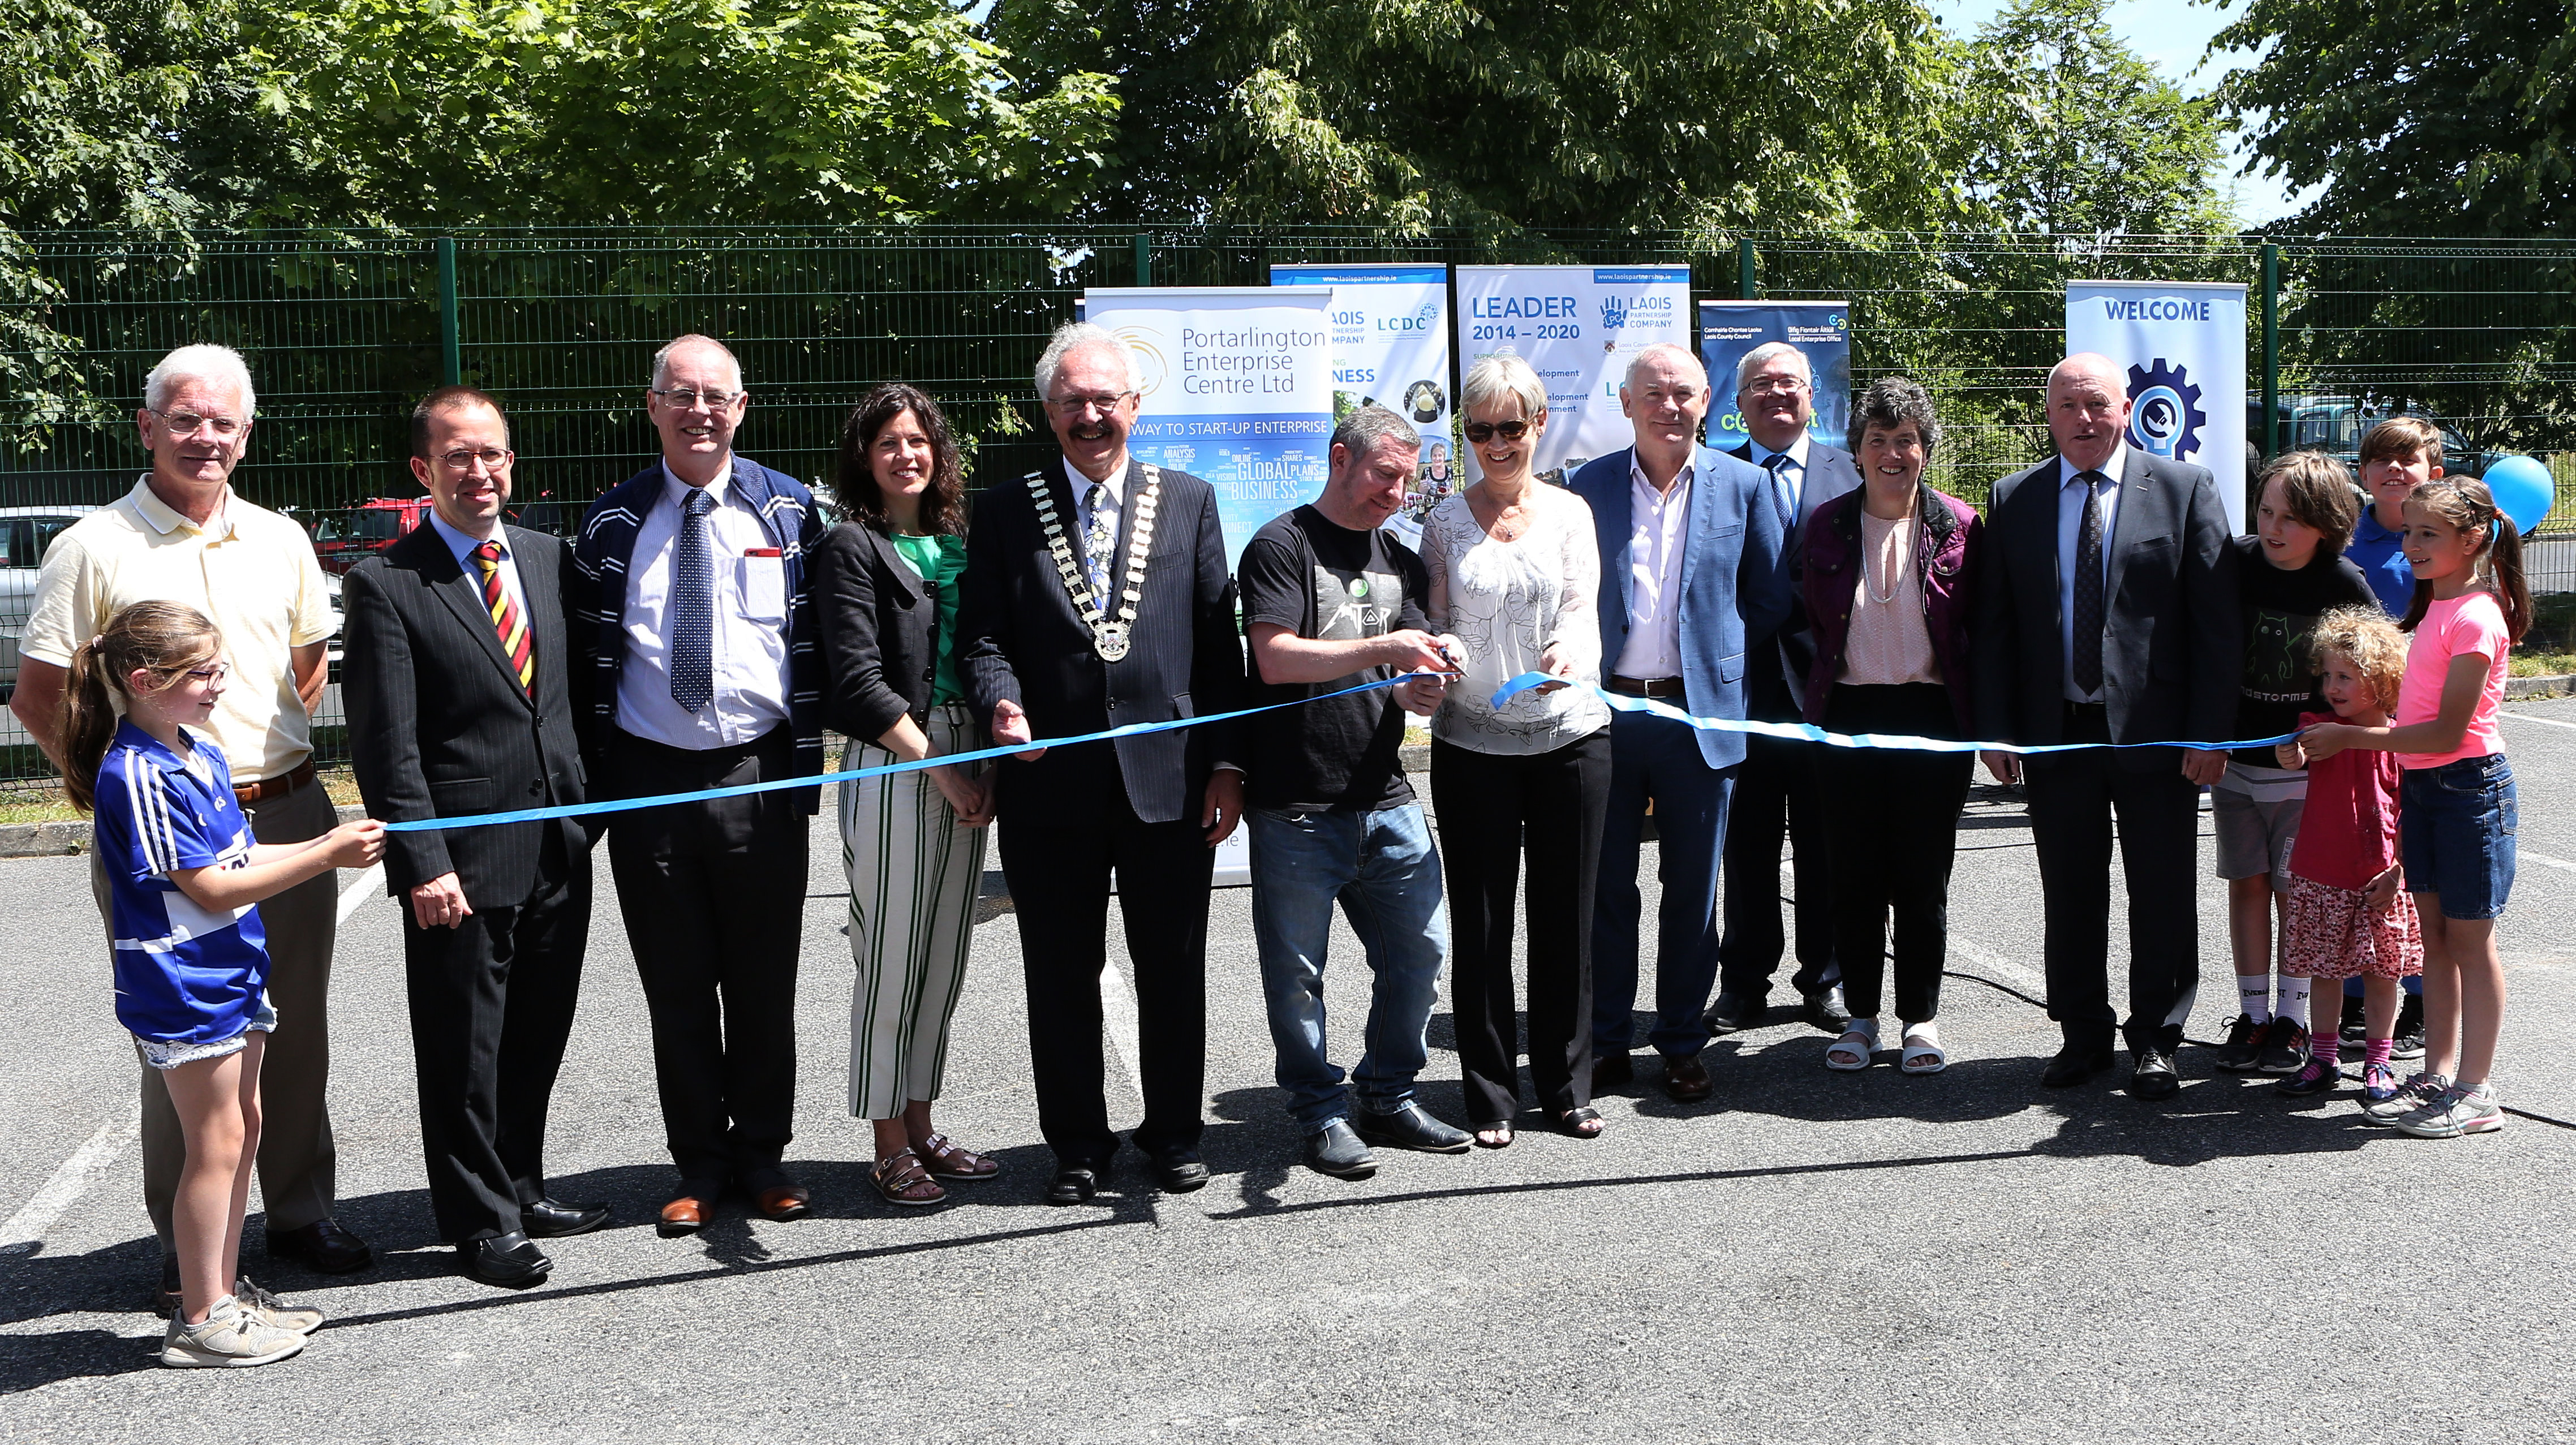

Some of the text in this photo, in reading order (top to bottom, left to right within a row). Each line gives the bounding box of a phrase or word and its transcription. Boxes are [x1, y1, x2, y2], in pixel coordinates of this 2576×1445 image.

[1473, 297, 1577, 318] LEADER
[1629, 297, 1672, 310] LAOIS
[1332, 311, 1365, 325] AOIS
[2104, 301, 2209, 321] WELCOME
[1378, 317, 1426, 331] LCDC
[1630, 320, 1672, 328] COMPANY
[1183, 326, 1326, 352] Portarlington
[1473, 325, 1516, 340] 2014
[1537, 324, 1580, 339] 2020
[1332, 336, 1365, 345] MPANY
[1184, 350, 1293, 375] Enterprise
[1332, 369, 1375, 383] NESS
[1537, 368, 1580, 379] elopment
[1184, 373, 1293, 394] Centre Ltd
[1547, 392, 1589, 403] elopment
[1128, 420, 1327, 436] WAY TO START-UP ENTERPRISE
[1163, 448, 1195, 459] ANALYSIS
[1232, 454, 1252, 463] ONLINE
[1237, 462, 1292, 480] GLOBAL
[1291, 464, 1319, 476] PLANS
[1231, 480, 1298, 501] BUSINESS
[1220, 521, 1253, 534] ONNECT
